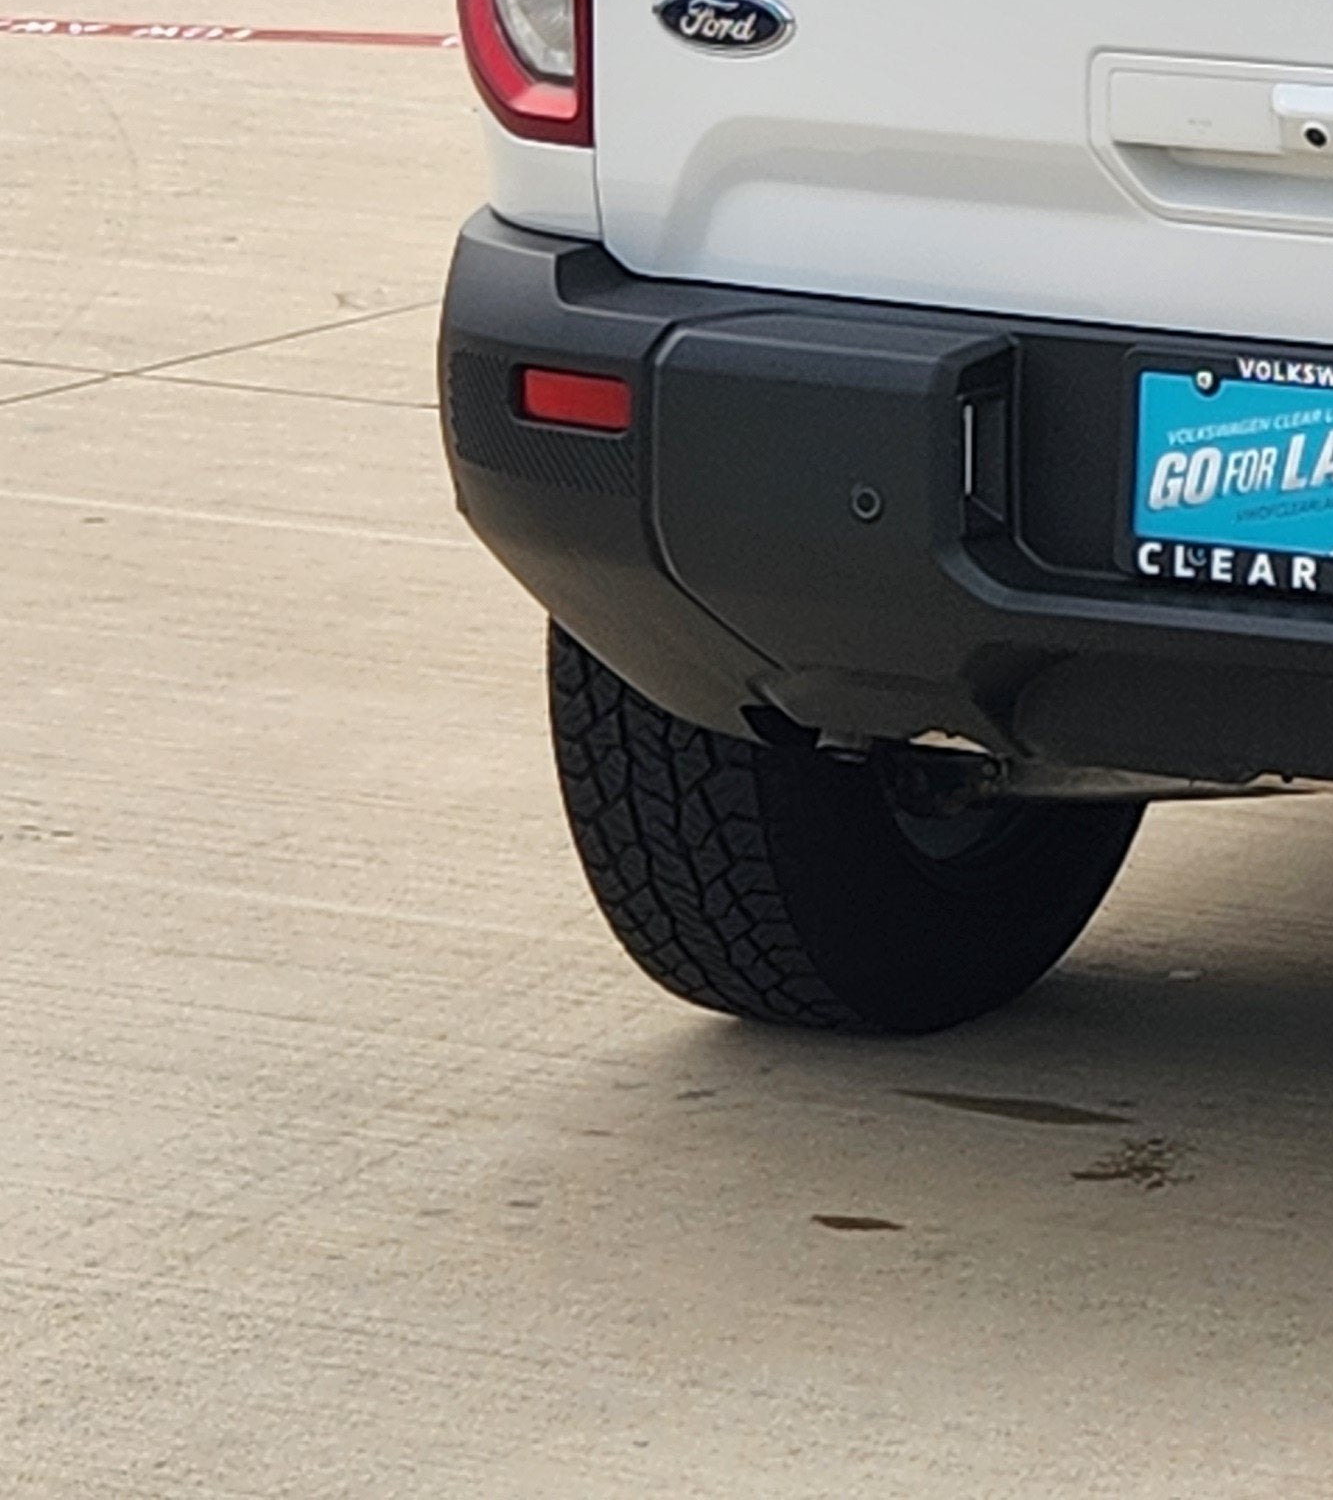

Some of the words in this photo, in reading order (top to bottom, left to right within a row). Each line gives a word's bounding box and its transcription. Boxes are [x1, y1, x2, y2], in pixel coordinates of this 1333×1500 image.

[1167, 416, 1272, 446] VOLKSWAGEN
[1273, 409, 1323, 431] CLEAR
[1147, 446, 1222, 510] GO
[1222, 446, 1278, 496] FOR
[1137, 541, 1317, 592] CLEAR
